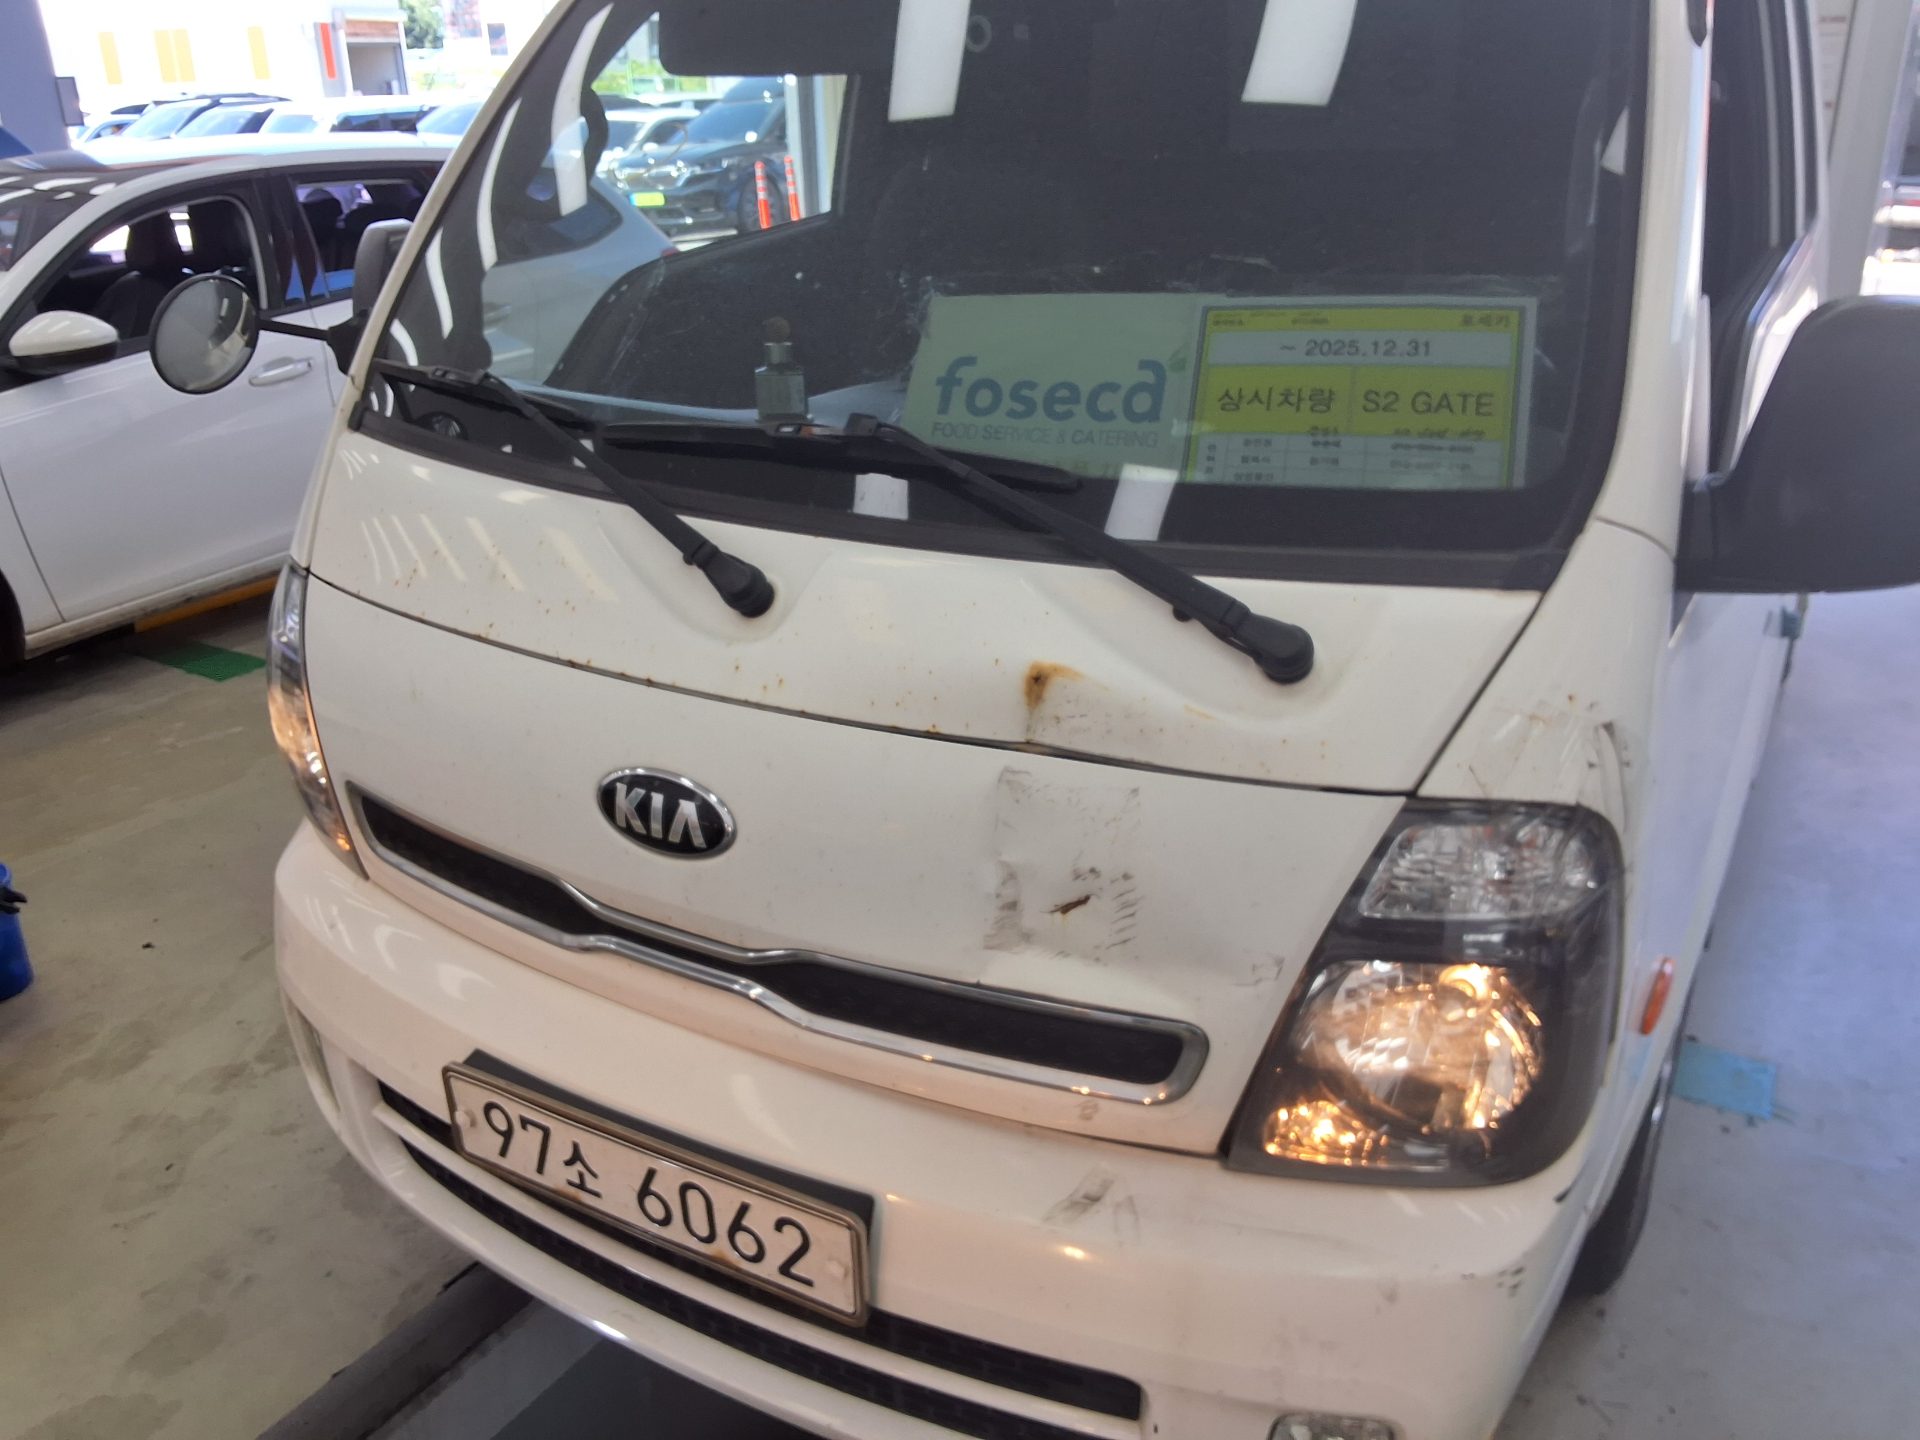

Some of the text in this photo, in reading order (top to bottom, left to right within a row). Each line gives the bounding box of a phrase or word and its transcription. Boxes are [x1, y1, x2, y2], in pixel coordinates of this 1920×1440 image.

[1304, 339, 1431, 358] 2025.12.31
[1217, 386, 1337, 413] 상시차량
[1362, 389, 1495, 417] S2 GATE
[931, 422, 978, 439] FOOD
[982, 424, 1051, 444] SERVICE
[1071, 429, 1159, 449] CATERING
[615, 782, 707, 849] KIA
[482, 1099, 815, 1288] 97소 6062
